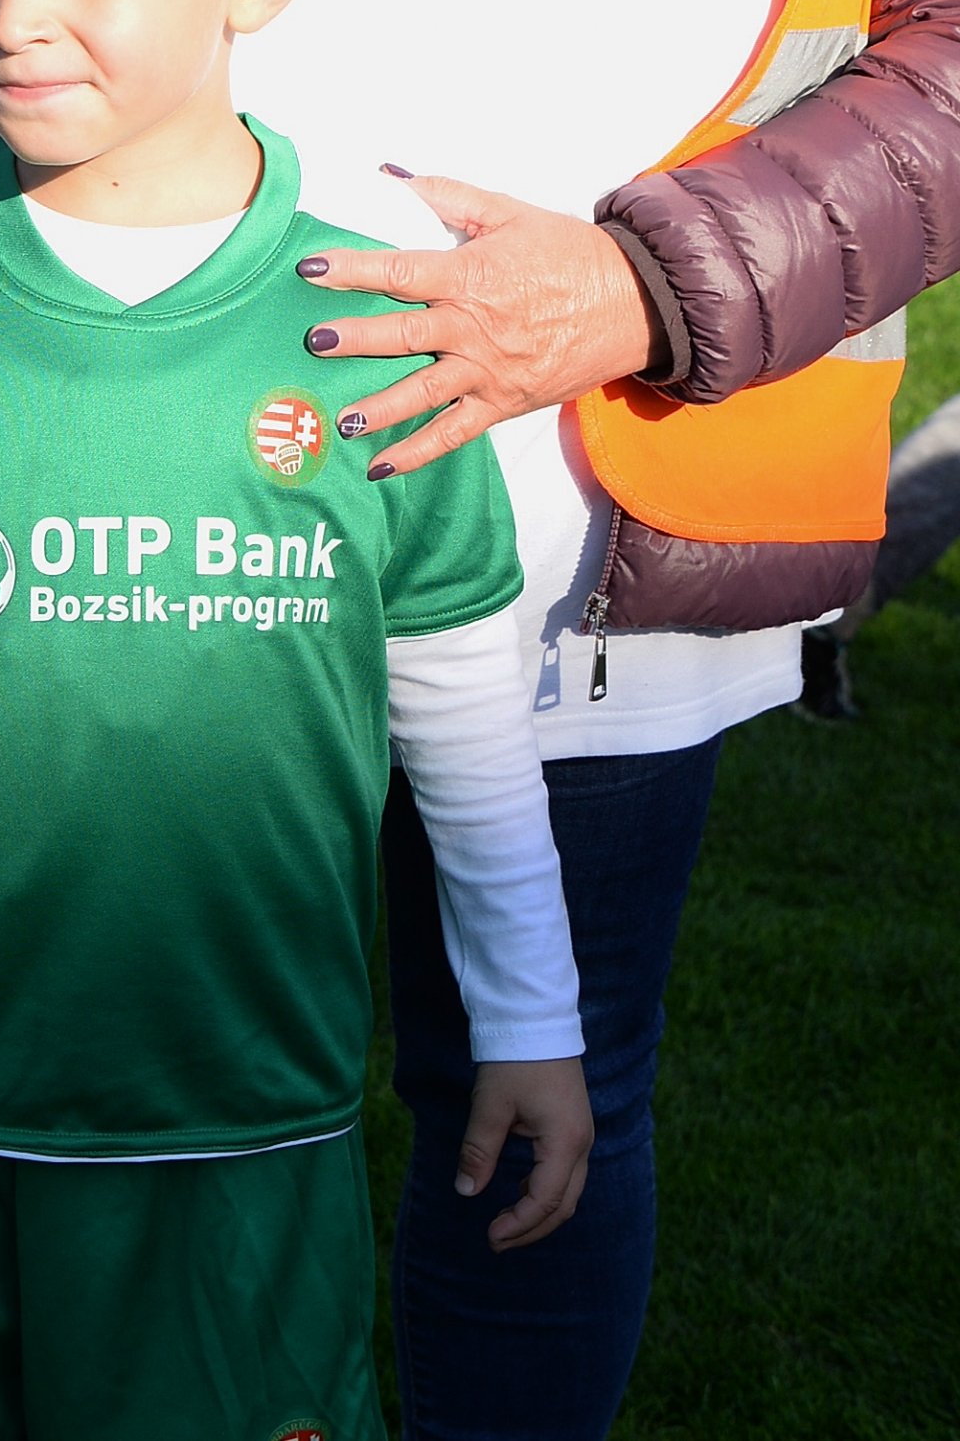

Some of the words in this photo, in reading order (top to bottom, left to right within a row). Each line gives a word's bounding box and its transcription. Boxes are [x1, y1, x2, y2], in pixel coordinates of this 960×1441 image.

[30, 516, 172, 577] OTP
[195, 516, 343, 579] Bank
[29, 585, 330, 631] Bozsik-program
